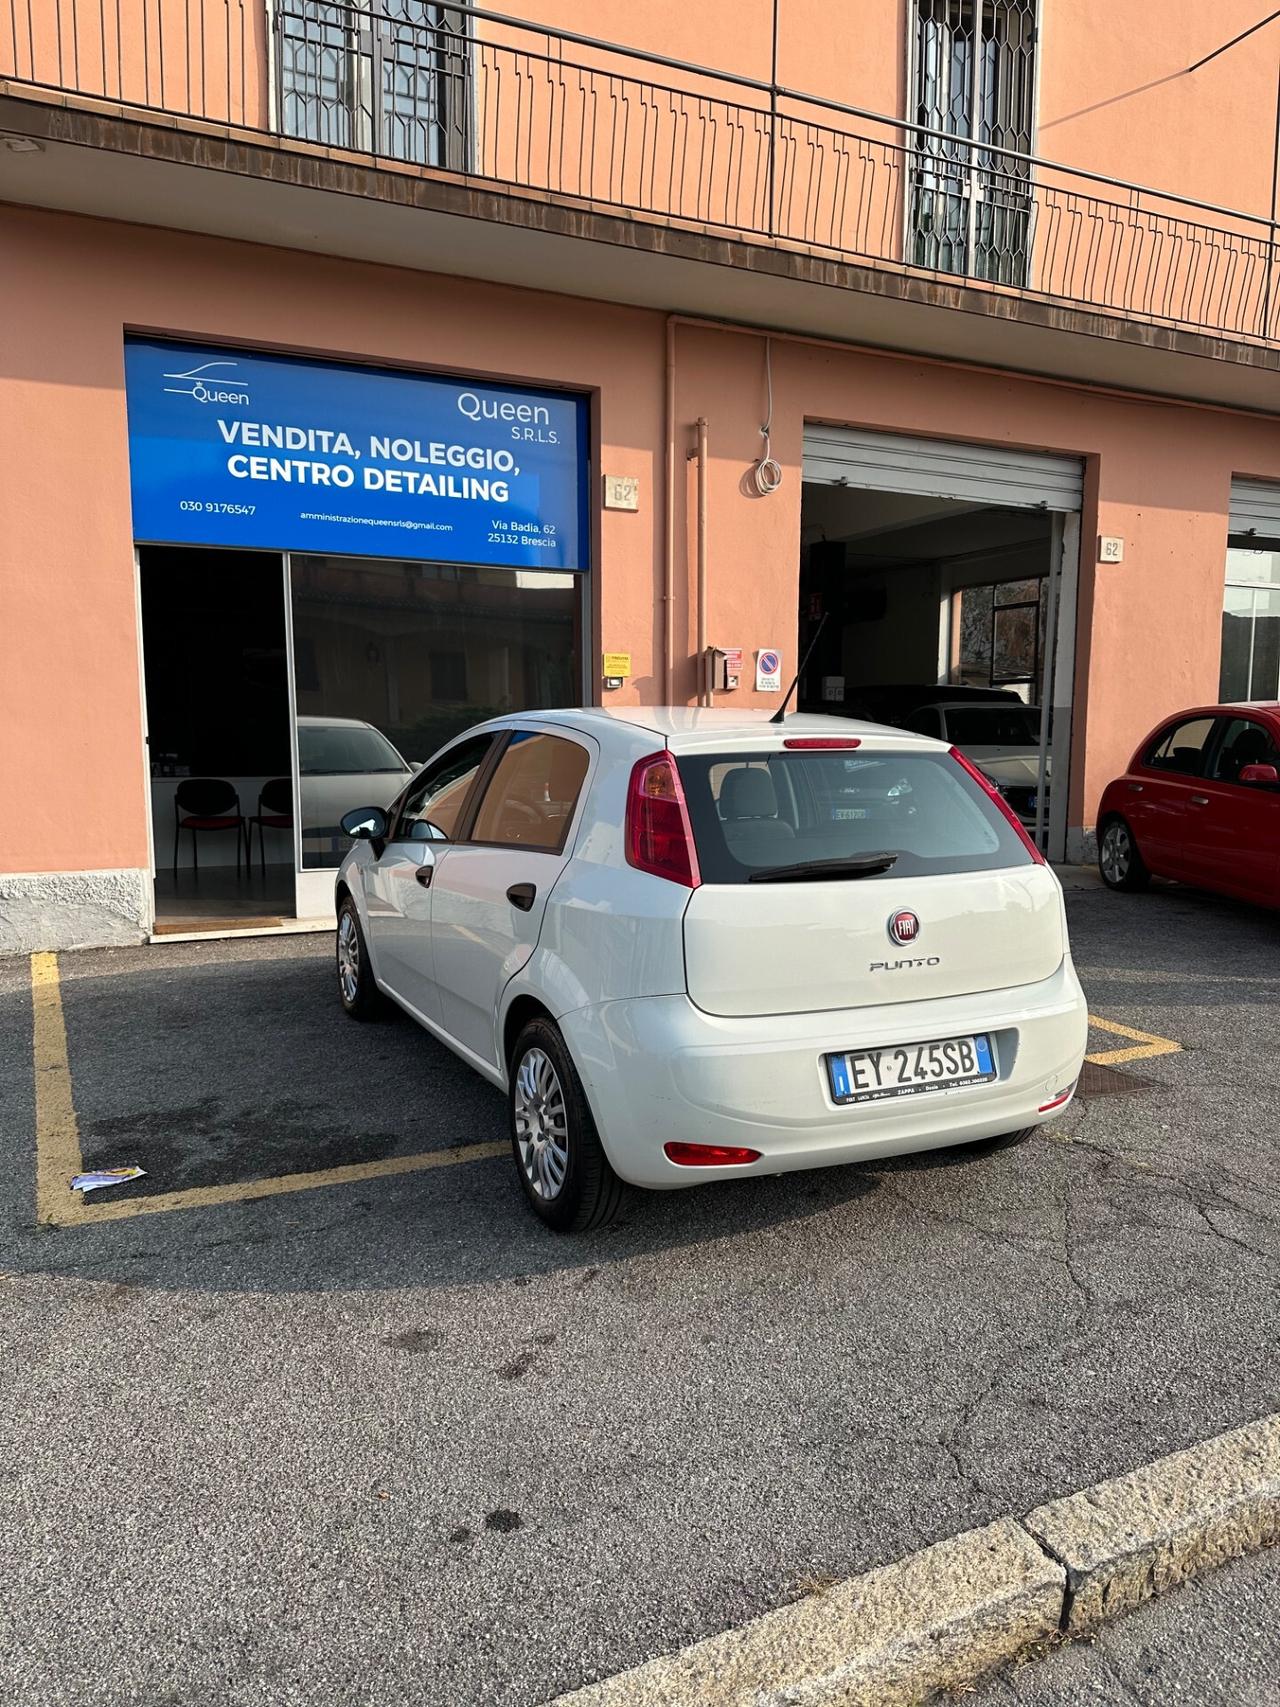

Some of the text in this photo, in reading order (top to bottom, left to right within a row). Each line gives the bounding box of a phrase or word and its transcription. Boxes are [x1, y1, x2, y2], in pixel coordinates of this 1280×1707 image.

[192, 384, 250, 406] Queen
[457, 392, 550, 426] Queen
[511, 426, 561, 445] S.R.L.S.
[217, 419, 520, 477] VENDITA, NOLEGGIO,
[227, 454, 509, 503] CENTRO DETAILING
[614, 483, 632, 501] 62
[180, 500, 256, 515] 030 9176547
[300, 511, 453, 531] amministrazionequeensrls@gmail.com
[491, 519, 556, 535] Via Badia, 62
[487, 532, 556, 548] 25132 Brescia
[1106, 542, 1118, 556] 62
[898, 919, 915, 936] FIAT
[869, 956, 940, 972] PUNTO
[850, 1051, 882, 1090] EY
[893, 1040, 976, 1083] 245SB
